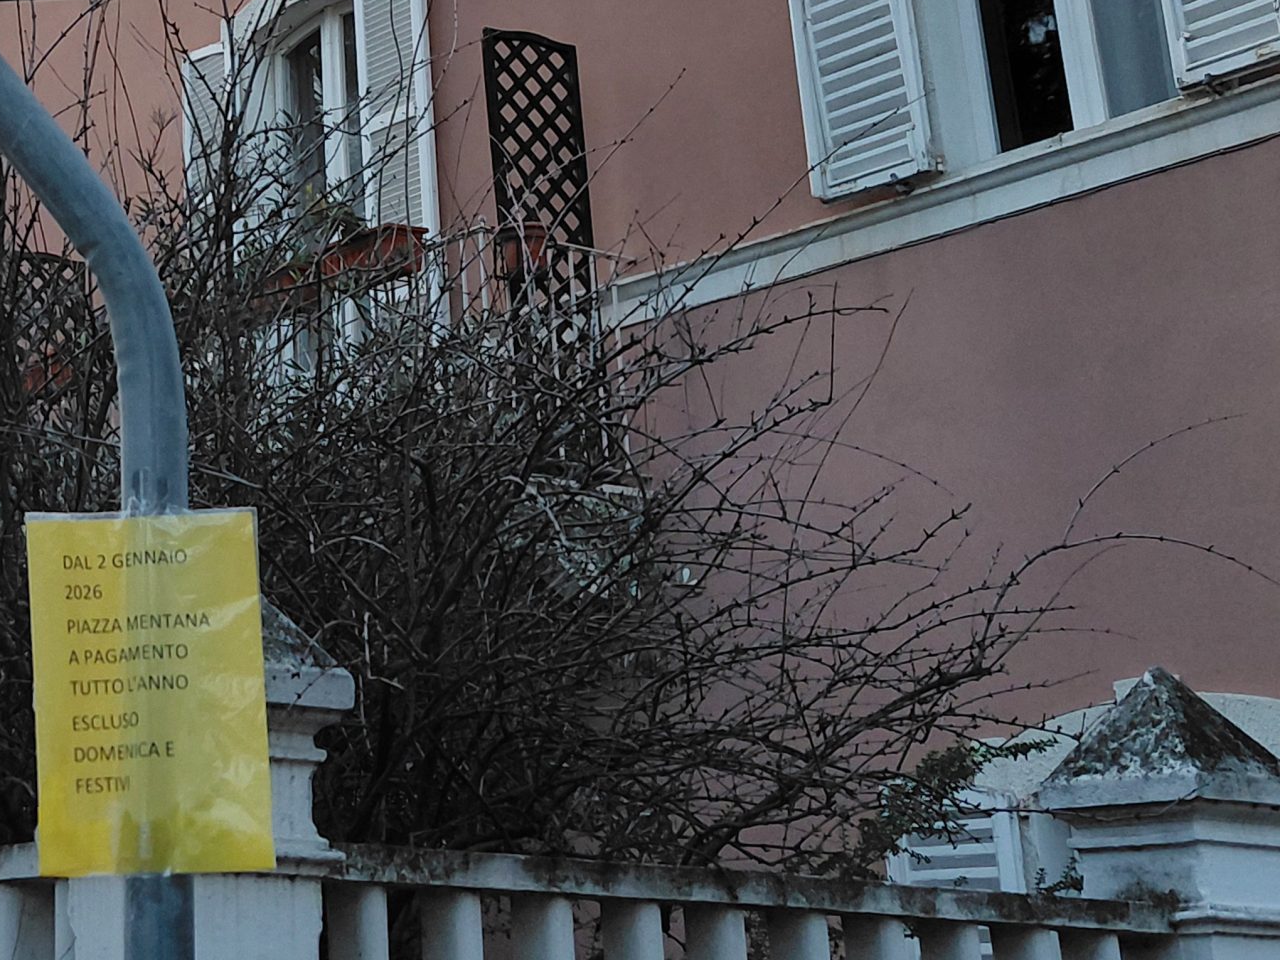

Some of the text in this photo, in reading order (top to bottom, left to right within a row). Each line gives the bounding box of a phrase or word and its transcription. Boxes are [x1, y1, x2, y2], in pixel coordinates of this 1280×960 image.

[63, 549, 187, 570] DAL 2 GENNAIO
[65, 584, 103, 600] 2026
[67, 612, 210, 634] PIAZZA MENTANA
[69, 644, 188, 664] A PAGAMENTO
[70, 679, 123, 696] TUTTO
[72, 712, 139, 731] ESCLUSO
[74, 741, 175, 763] DOMENICA E
